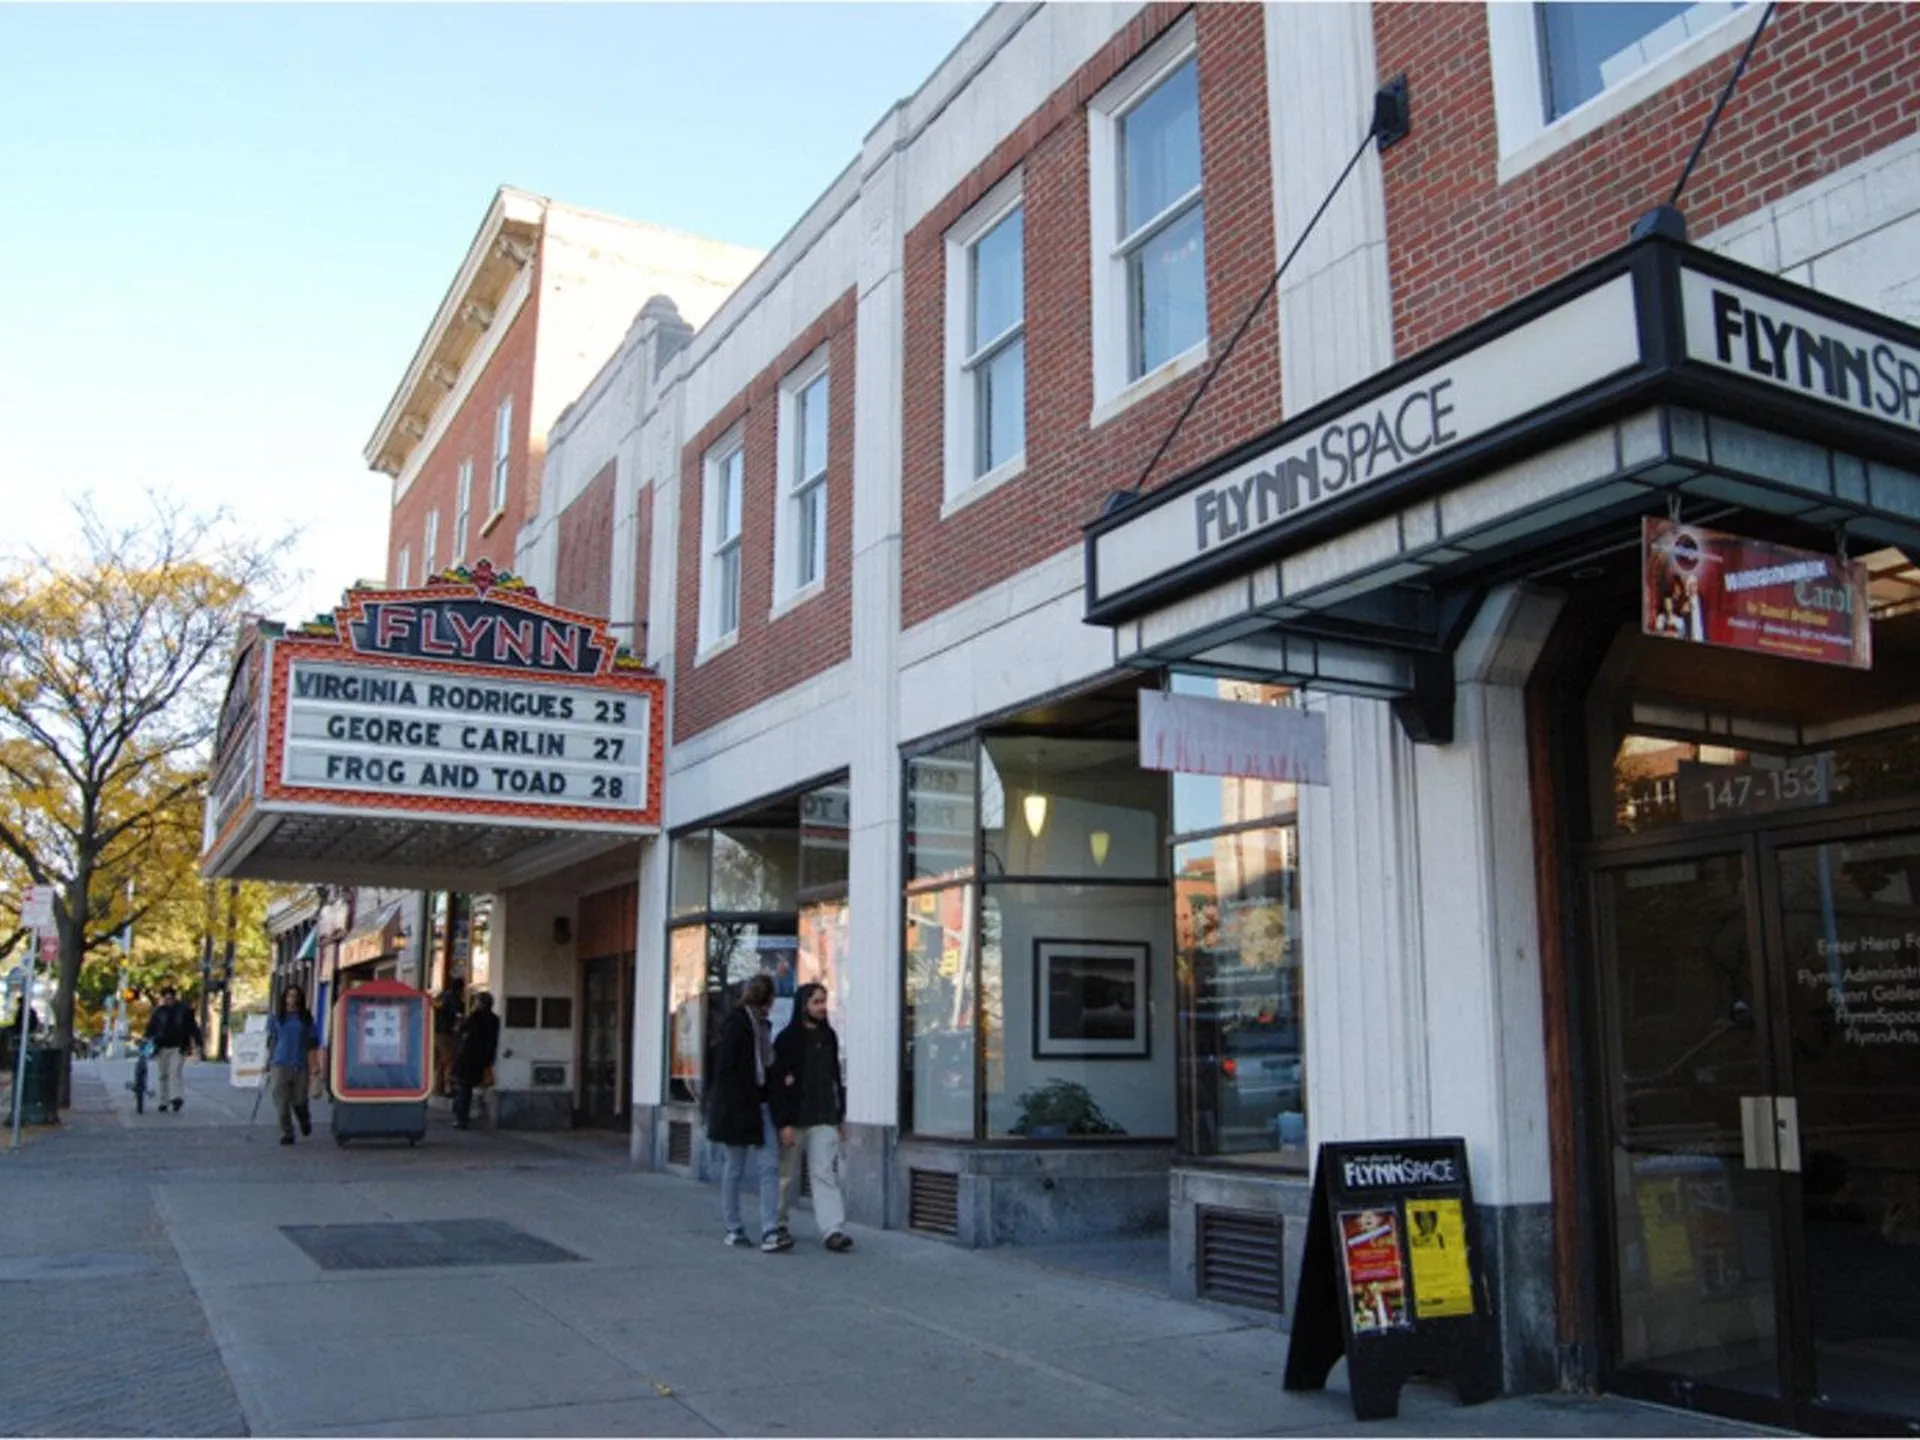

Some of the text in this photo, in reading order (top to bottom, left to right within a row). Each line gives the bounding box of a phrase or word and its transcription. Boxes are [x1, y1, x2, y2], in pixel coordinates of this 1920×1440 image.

[1711, 288, 1920, 426] FLYNNSP
[1195, 378, 1457, 551] FLYNNSPACE
[376, 604, 580, 671] FLYNN
[295, 669, 627, 724] VIRGINIA RODRIGUES 25
[327, 714, 625, 761] GEORGE CARLIN 27
[326, 755, 623, 799] FROG AND TOAD 28
[1703, 765, 1822, 811] 147-153
[1344, 1158, 1456, 1187] FLYNNSPACE
